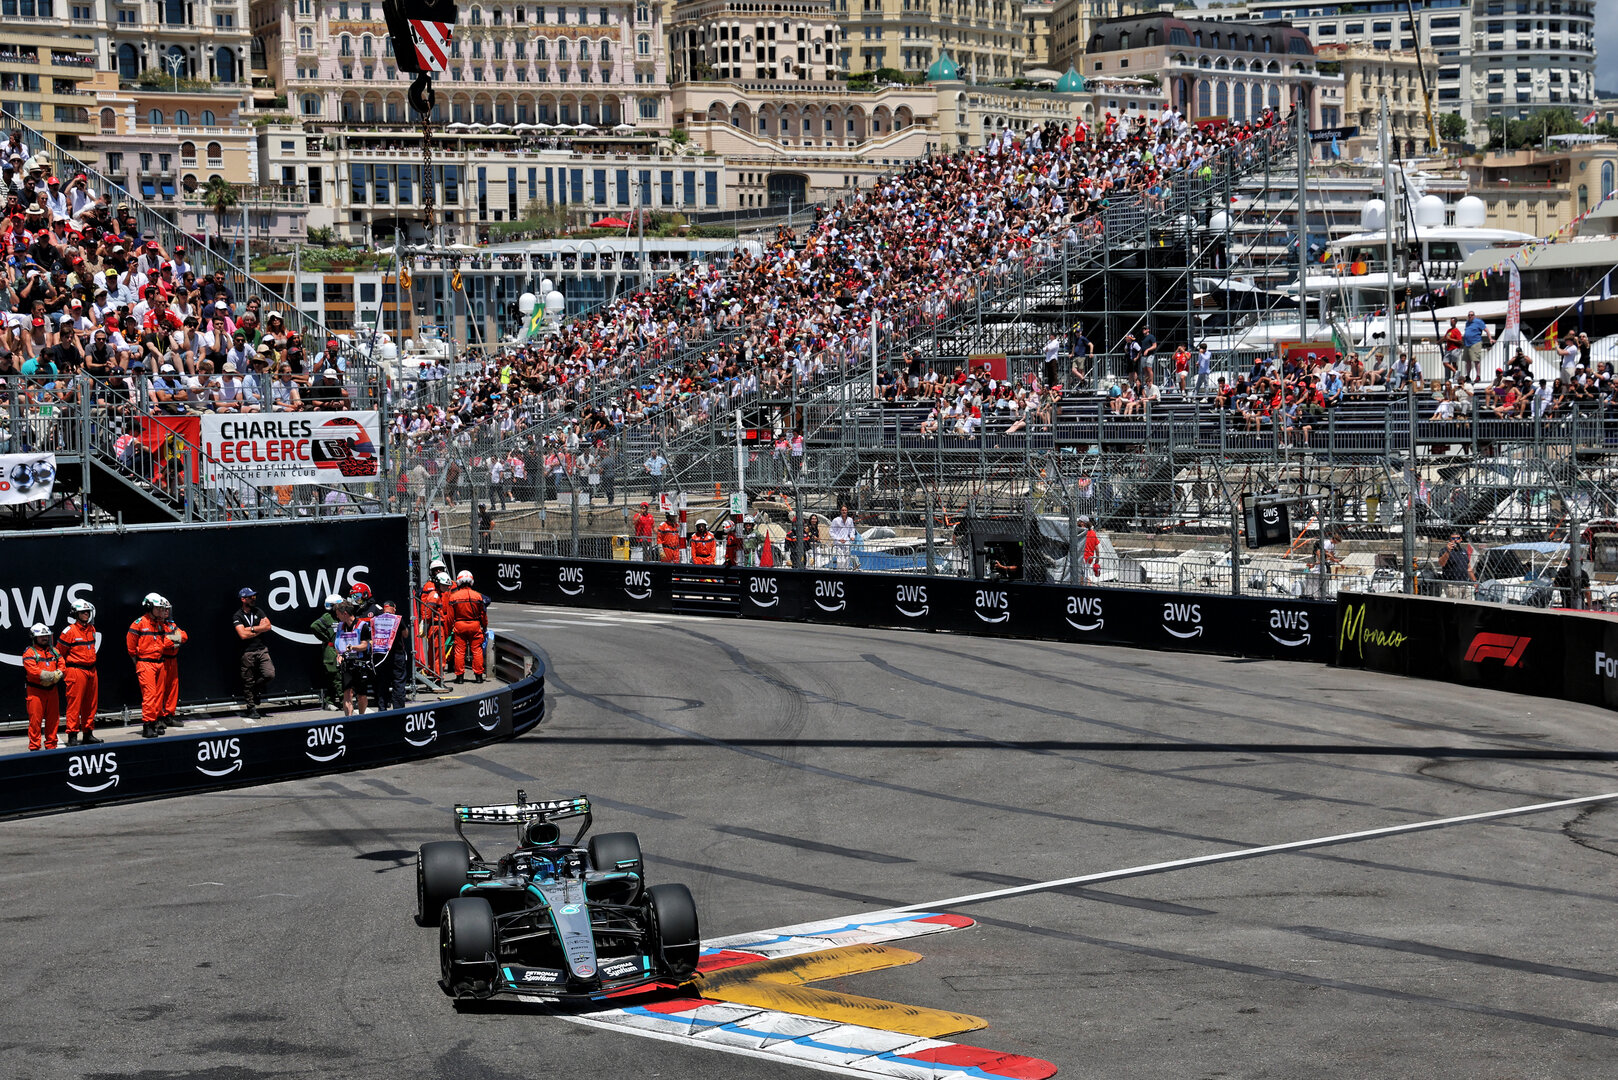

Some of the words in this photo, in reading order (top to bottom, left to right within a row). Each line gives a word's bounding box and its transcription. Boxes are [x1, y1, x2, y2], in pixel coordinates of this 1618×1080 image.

[221, 420, 312, 439] CHARLES
[206, 439, 310, 463] LECLERC
[217, 471, 261, 480] MARCHE
[267, 470, 286, 478] FAN
[291, 469, 316, 477] CLUB
[256, 463, 304, 471] OFFICIAL
[1263, 507, 1279, 518] aws
[498, 563, 521, 578] aws
[558, 567, 584, 582] aws
[624, 571, 651, 586] aws
[750, 577, 778, 593] aws
[816, 580, 845, 597] aws
[896, 585, 928, 602] aws
[976, 590, 1008, 608] aws
[1066, 596, 1103, 615] aws
[1163, 603, 1202, 622] aws
[1270, 609, 1309, 630] aws
[1339, 603, 1408, 658] Monaco
[478, 696, 499, 717] aws
[406, 711, 436, 732] aws
[307, 725, 345, 747] aws
[198, 738, 241, 761] aws
[69, 752, 118, 776] aws
[603, 962, 634, 972] PETRONAS
[606, 965, 638, 977] Syntium
